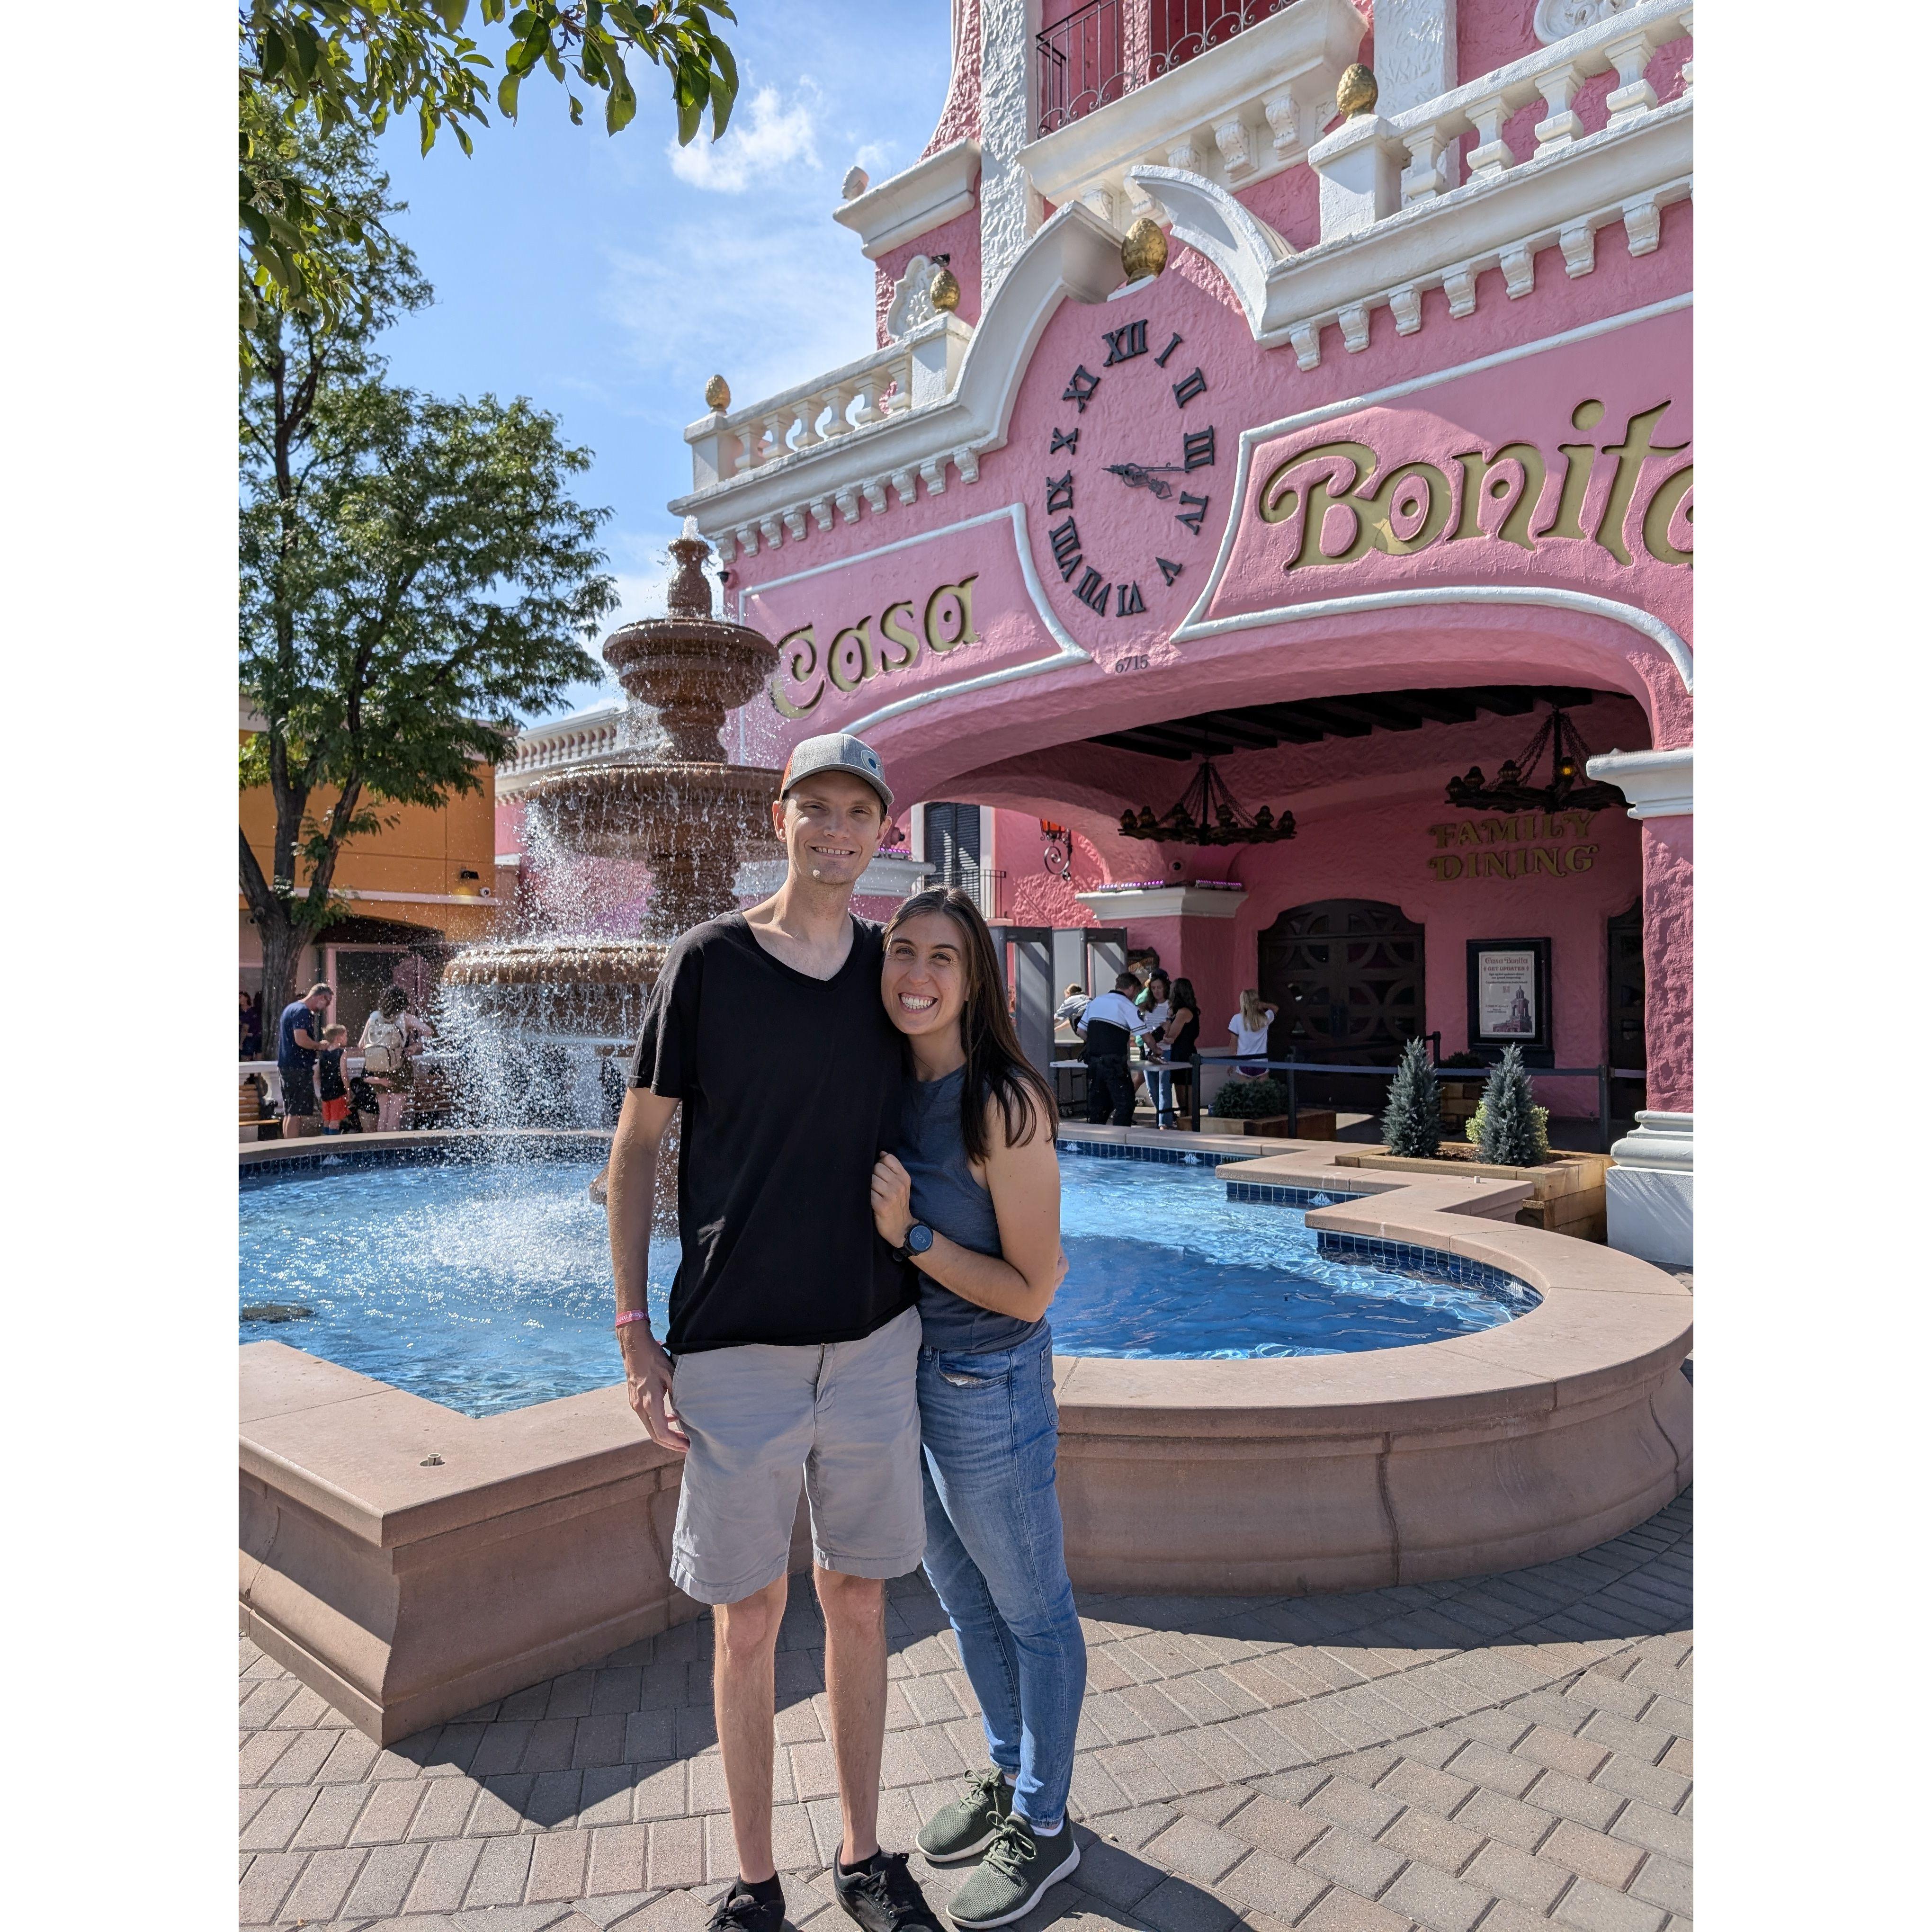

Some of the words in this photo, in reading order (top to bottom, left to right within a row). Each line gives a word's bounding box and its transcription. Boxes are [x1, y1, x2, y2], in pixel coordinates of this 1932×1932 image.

[1102, 319, 1149, 367] XII
[1154, 332, 1183, 368] I
[1061, 364, 1101, 413] XI
[1172, 367, 1207, 409] II
[1049, 427, 1079, 455] X
[1183, 425, 1214, 473] III
[1046, 470, 1073, 515] IX
[1175, 491, 1210, 536] IV
[1048, 515, 1083, 583] VIII
[1073, 565, 1111, 617] VII
[1155, 557, 1183, 587] V
[1115, 581, 1147, 617] VI
[769, 572, 981, 719] Casa
[1115, 654, 1149, 673] 6715
[1427, 812, 1597, 849] FAMILY
[1428, 844, 1600, 881] DINING
